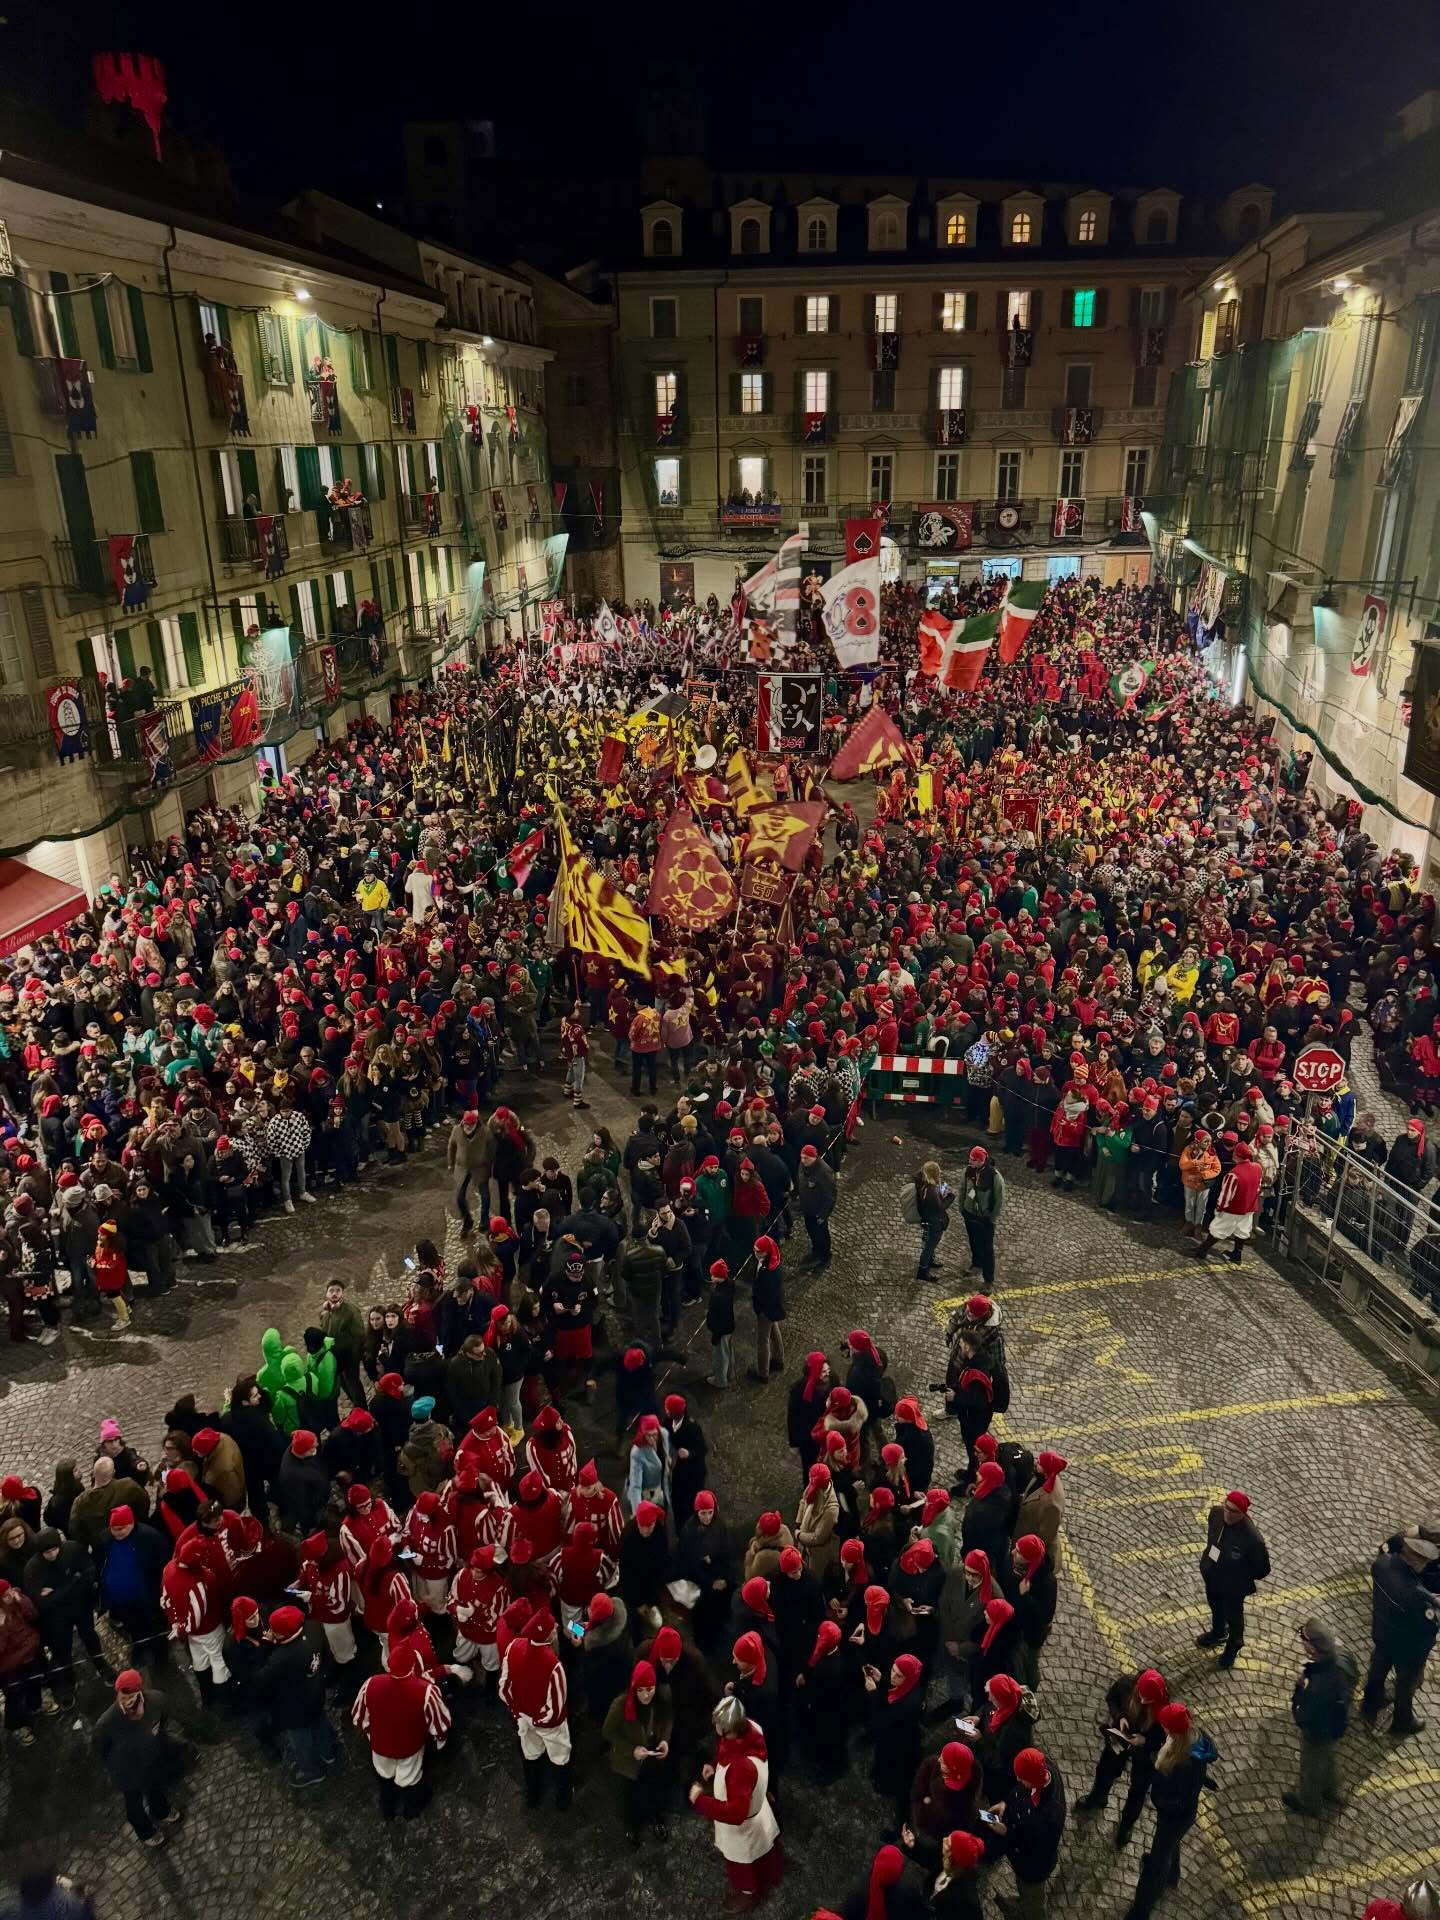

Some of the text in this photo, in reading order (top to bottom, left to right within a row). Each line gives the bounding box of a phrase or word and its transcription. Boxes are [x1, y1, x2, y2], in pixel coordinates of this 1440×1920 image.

[202, 692, 222, 706] PICCHE
[773, 735, 806, 749] 1954
[1297, 1061, 1342, 1079] STOP
